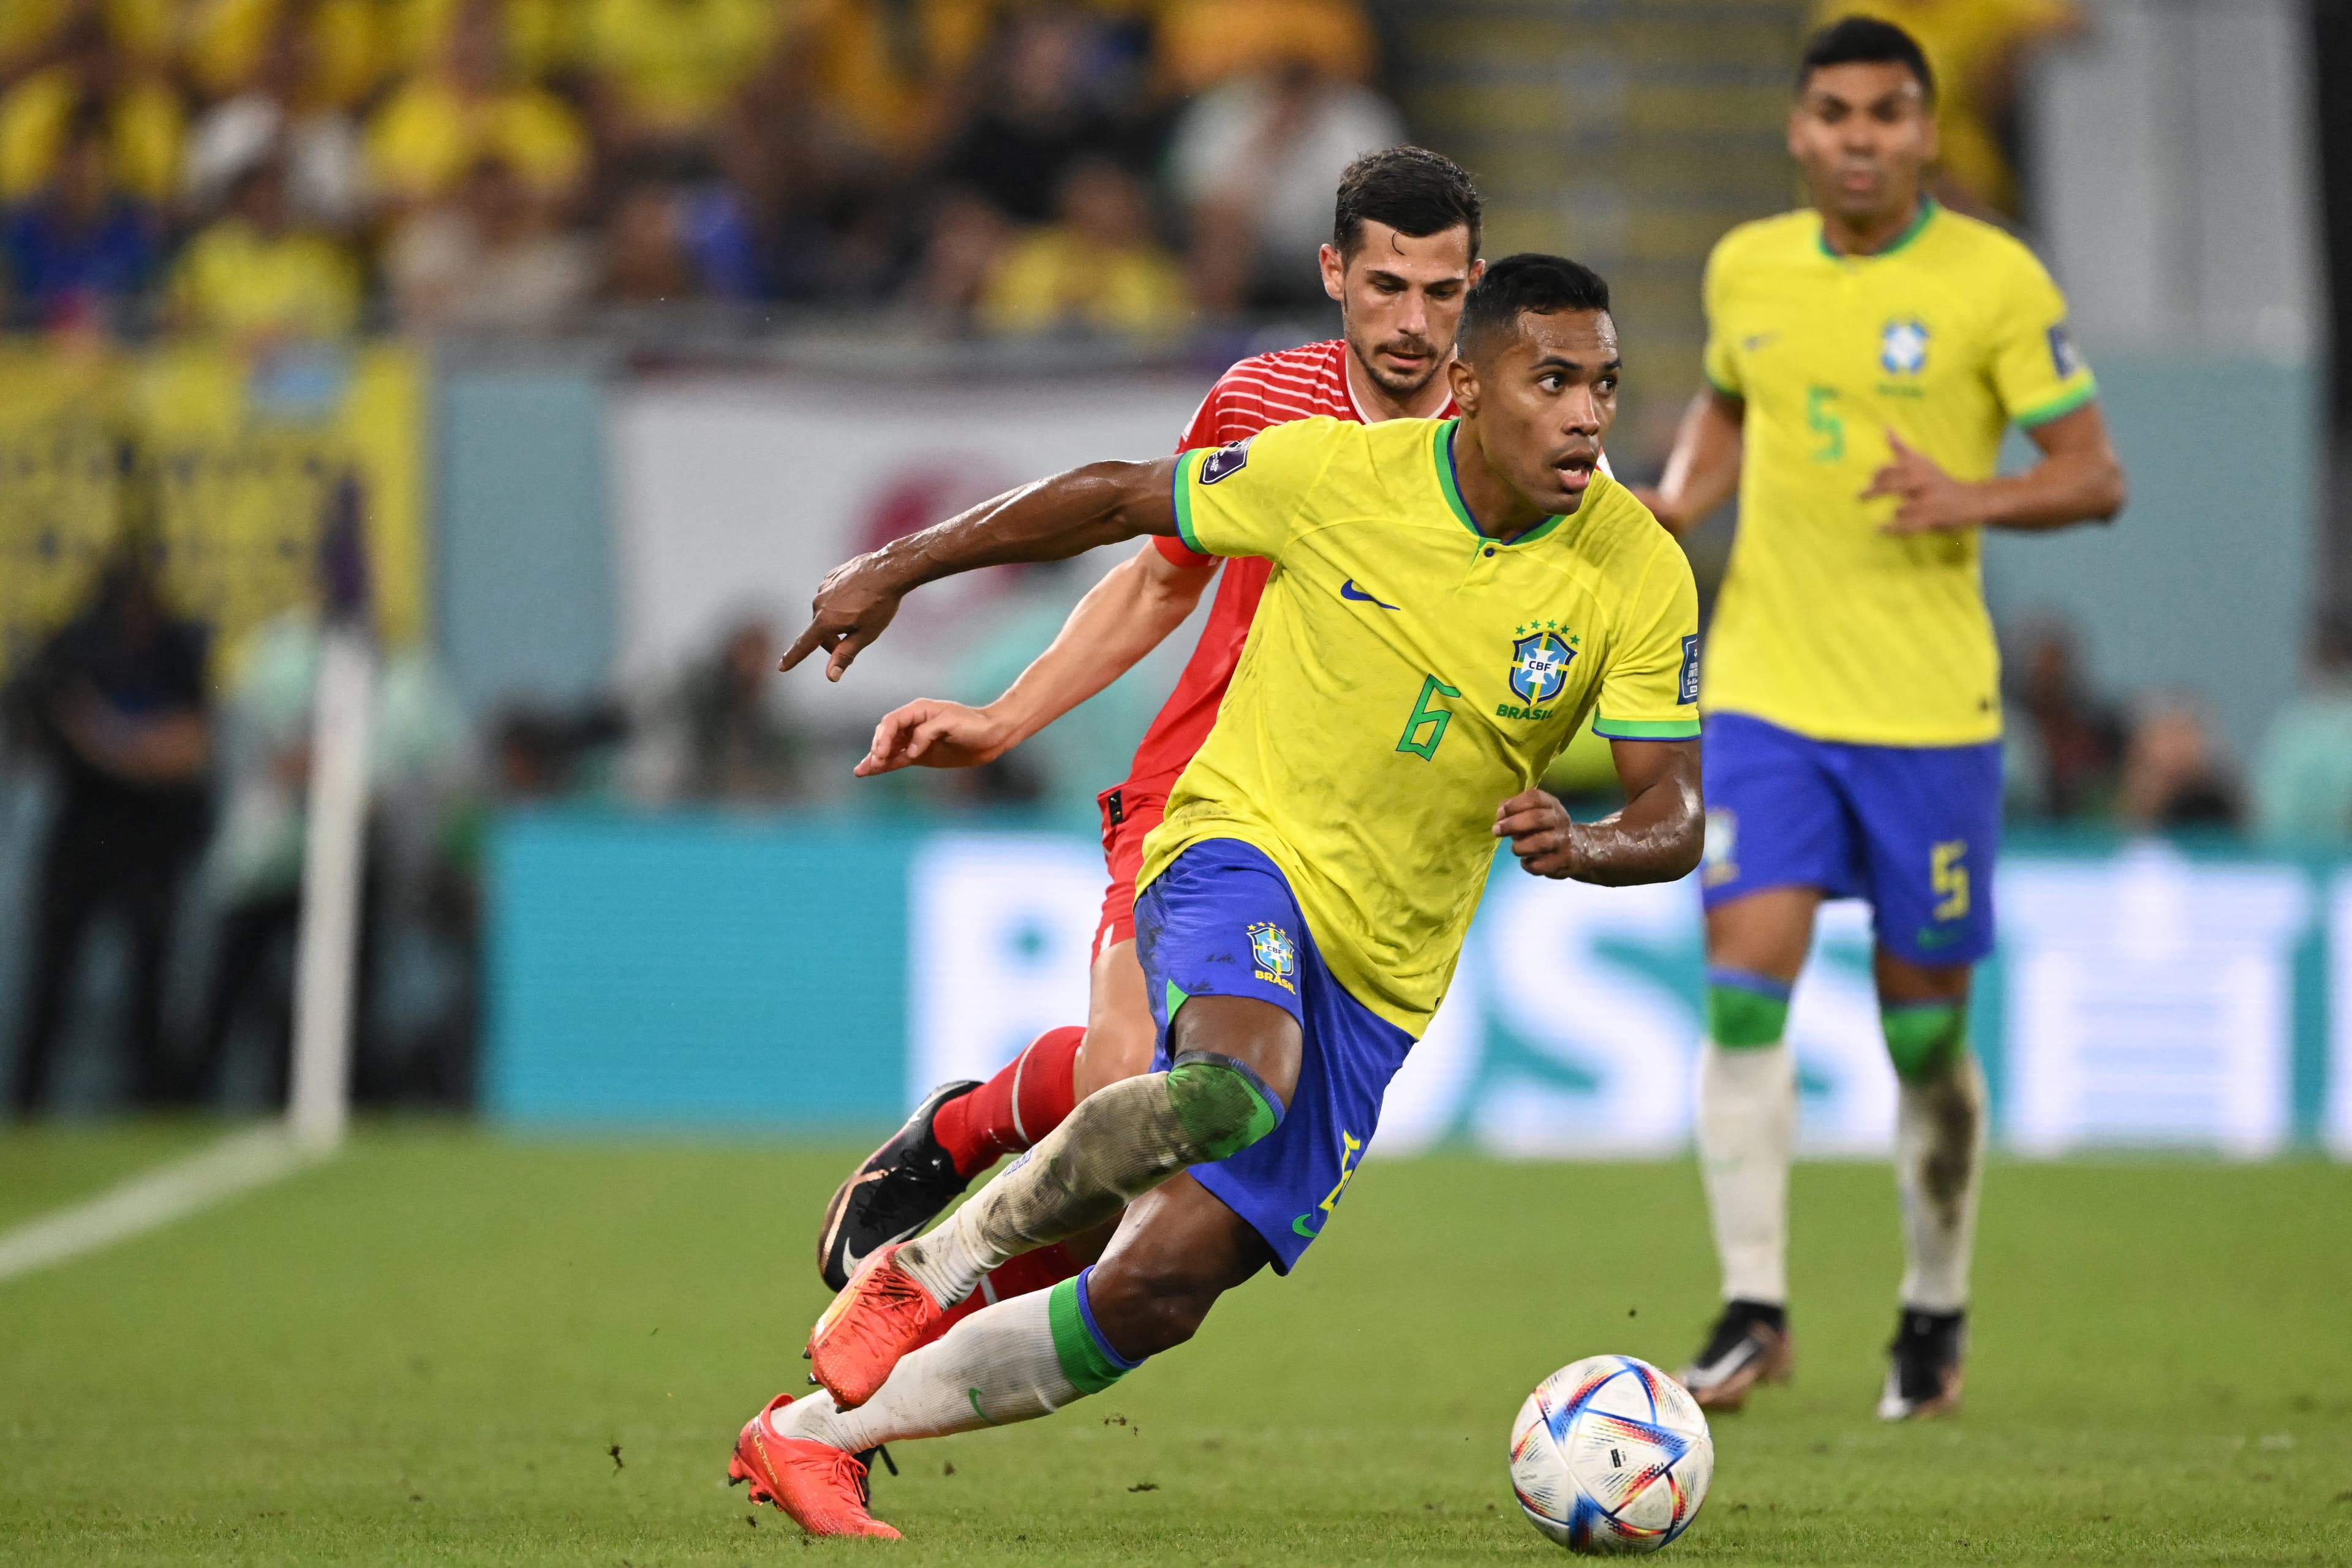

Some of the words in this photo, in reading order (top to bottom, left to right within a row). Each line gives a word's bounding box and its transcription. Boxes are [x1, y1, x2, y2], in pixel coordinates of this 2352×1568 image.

[1806, 385, 1844, 463] 5
[1528, 660, 1552, 671] CBF
[1395, 673, 1461, 762] 6
[1496, 704, 1555, 721] BRASIL
[1929, 838, 1971, 921] 5
[1267, 945, 1283, 955] CBF
[1254, 970, 1297, 995] BRASIL
